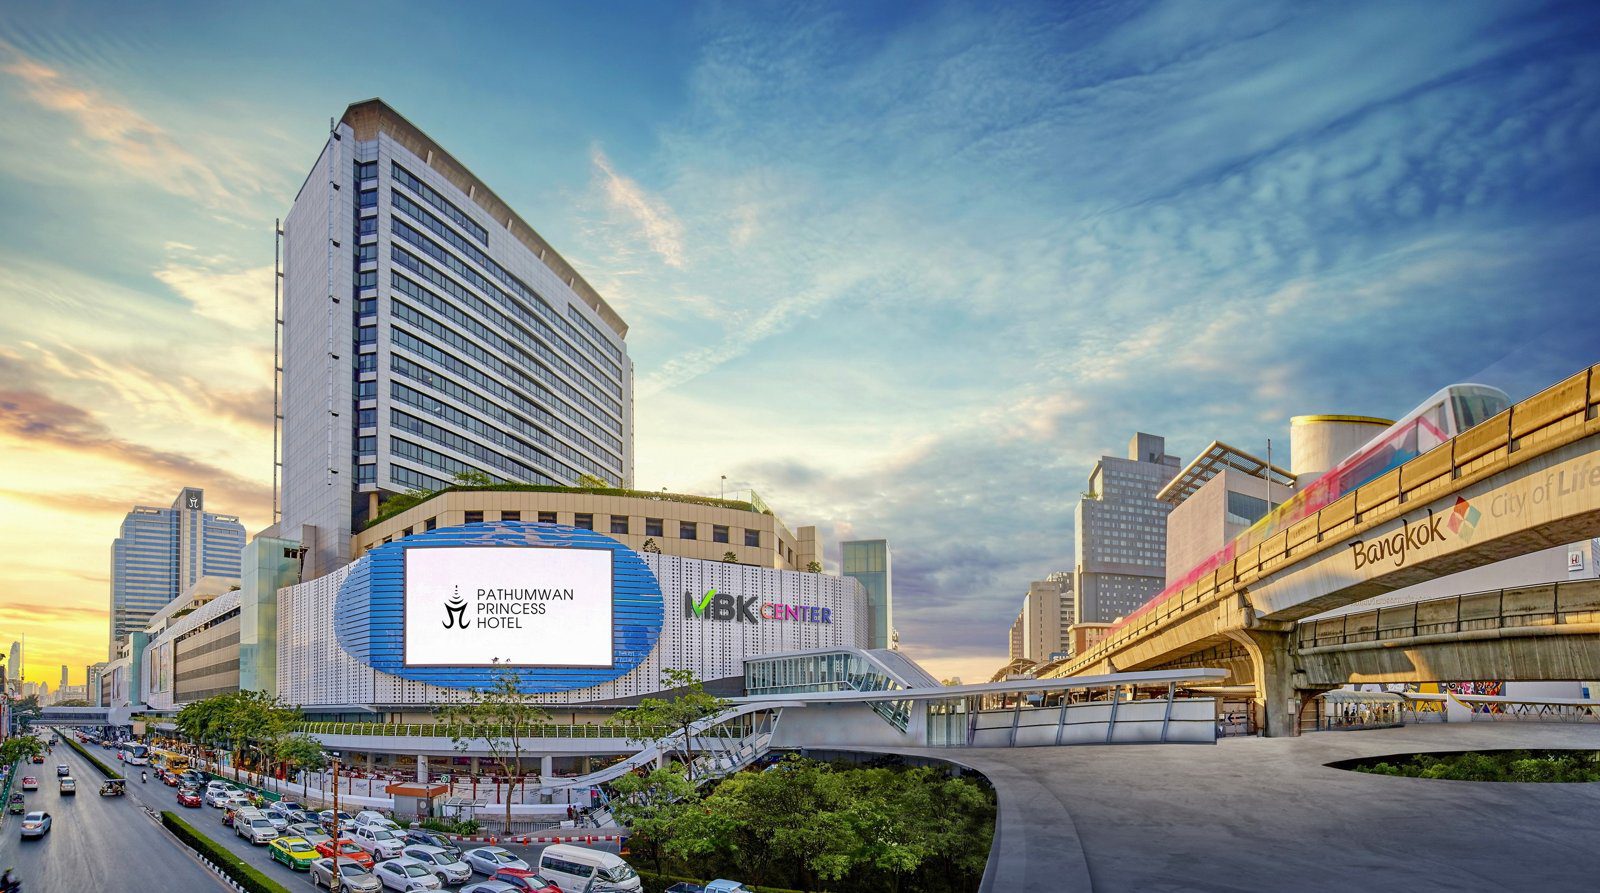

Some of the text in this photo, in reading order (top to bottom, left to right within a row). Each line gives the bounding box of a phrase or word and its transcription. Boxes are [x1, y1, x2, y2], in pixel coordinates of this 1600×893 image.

[1491, 460, 1600, 518] City of Life
[1349, 509, 1447, 570] Bangkok
[477, 589, 574, 600] PATHUMWAN
[477, 603, 546, 614] PRINCESS
[685, 589, 832, 625] MBK CENTER
[477, 617, 522, 629] HOTEL
